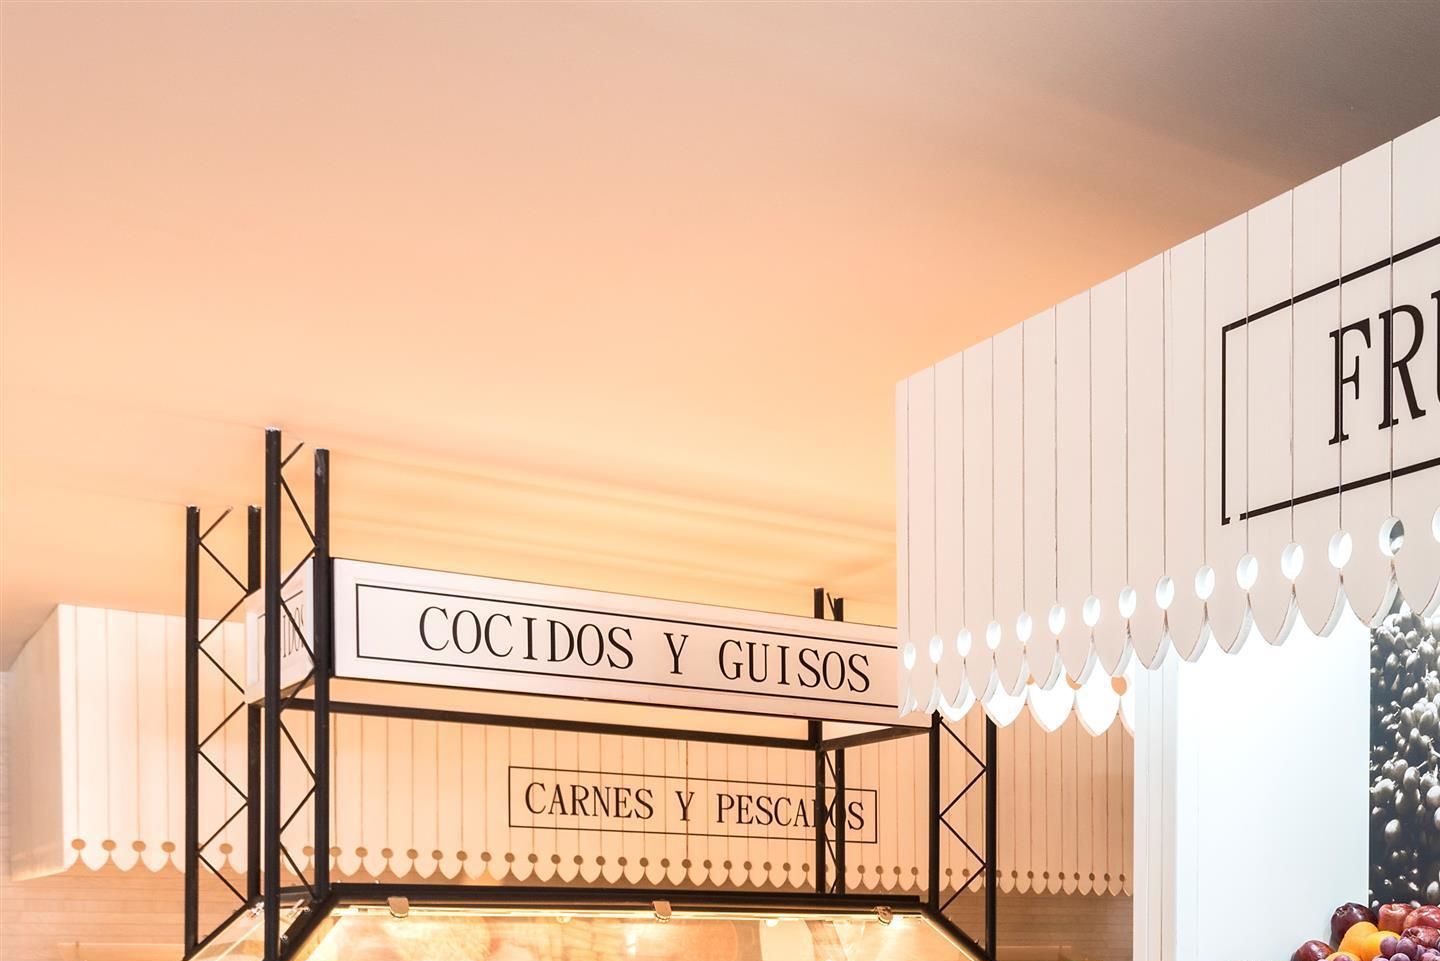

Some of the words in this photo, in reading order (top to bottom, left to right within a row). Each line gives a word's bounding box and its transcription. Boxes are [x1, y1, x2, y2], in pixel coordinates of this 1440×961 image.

[419, 606, 634, 670] COCIDOS
[663, 632, 689, 675] Y
[718, 639, 870, 693] GUISOS
[525, 782, 654, 820] CARNES
[675, 790, 695, 822] Y
